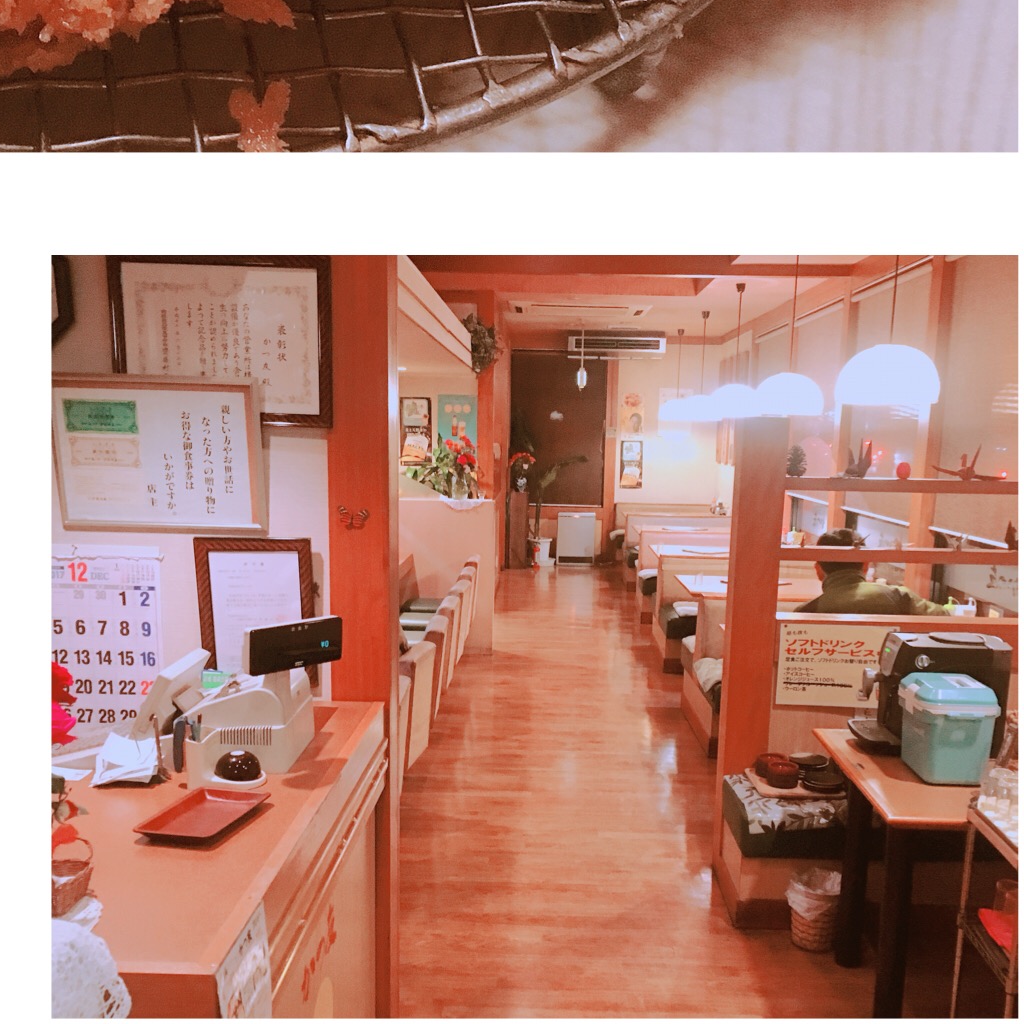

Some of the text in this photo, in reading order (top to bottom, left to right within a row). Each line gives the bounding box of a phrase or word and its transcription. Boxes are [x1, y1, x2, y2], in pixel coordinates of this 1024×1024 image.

[276, 323, 288, 362] 表彰状
[181, 411, 194, 490] お得な御食事券は
[221, 404, 234, 494] 親しい方やお世話に
[201, 416, 216, 514] なった方への贈り物に
[68, 562, 88, 582] 12
[91, 572, 109, 580] DEC
[118, 591, 127, 606] 1
[139, 591, 151, 607] 2
[52, 619, 152, 637] 5 6 7 8 9
[785, 639, 865, 648] ソフトドリンク
[52, 649, 156, 667] 12 13 14 15 16
[75, 679, 93, 694] 20
[98, 679, 113, 695] 21
[119, 680, 136, 695] 22
[77, 708, 93, 723] 27
[98, 709, 116, 724] 28
